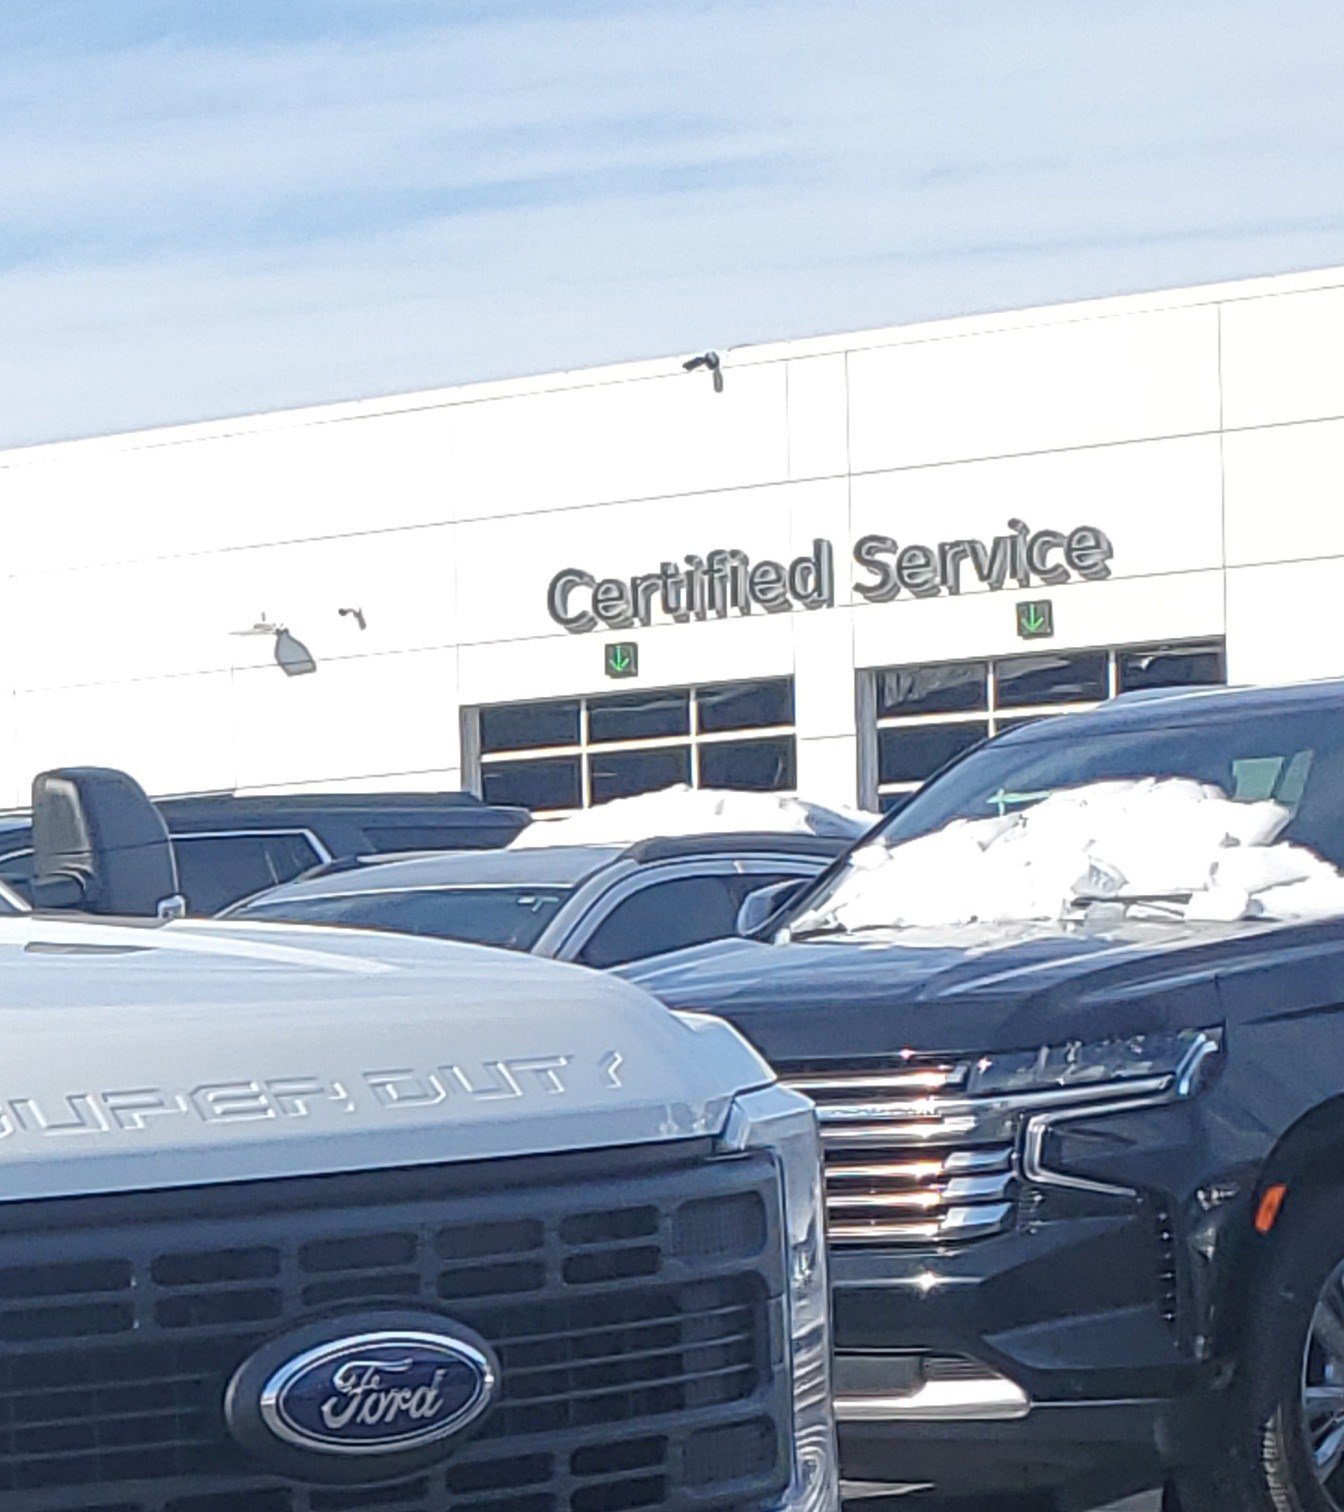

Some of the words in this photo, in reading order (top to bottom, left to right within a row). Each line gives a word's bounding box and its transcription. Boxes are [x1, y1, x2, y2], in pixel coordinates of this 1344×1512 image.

[547, 536, 833, 634] Certified
[853, 519, 1113, 600] Service
[322, 1358, 448, 1430] Ford
